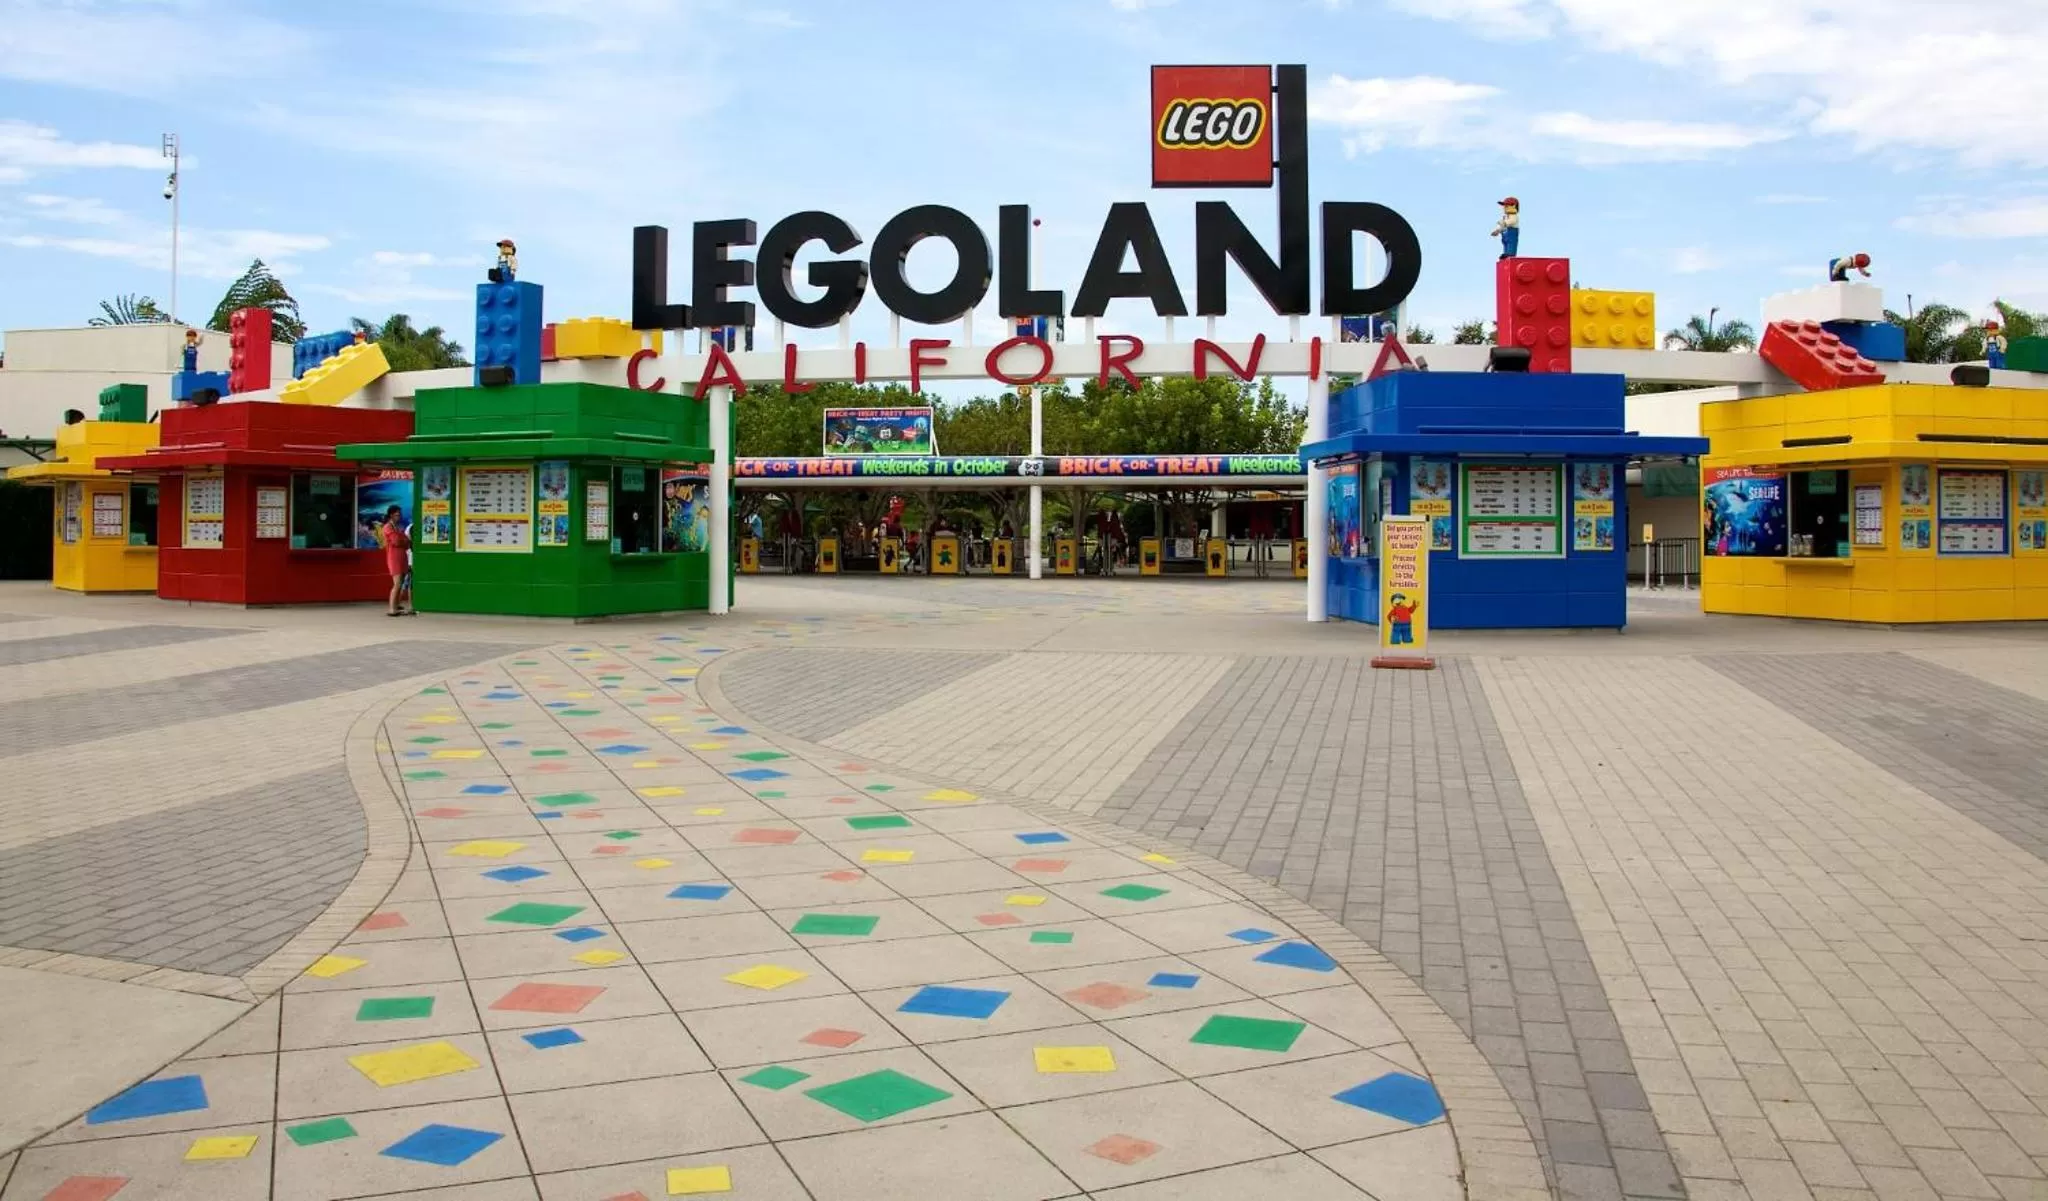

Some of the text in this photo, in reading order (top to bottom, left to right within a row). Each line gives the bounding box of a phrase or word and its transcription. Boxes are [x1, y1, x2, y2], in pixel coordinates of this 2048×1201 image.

[1163, 103, 1260, 144] LEGO
[632, 200, 1422, 332] LEGOLAND
[627, 333, 1413, 401] CALIFORNIA
[736, 458, 1009, 476] ICK-OR-TREAT Weekends in October
[1228, 456, 1302, 474] Weekends
